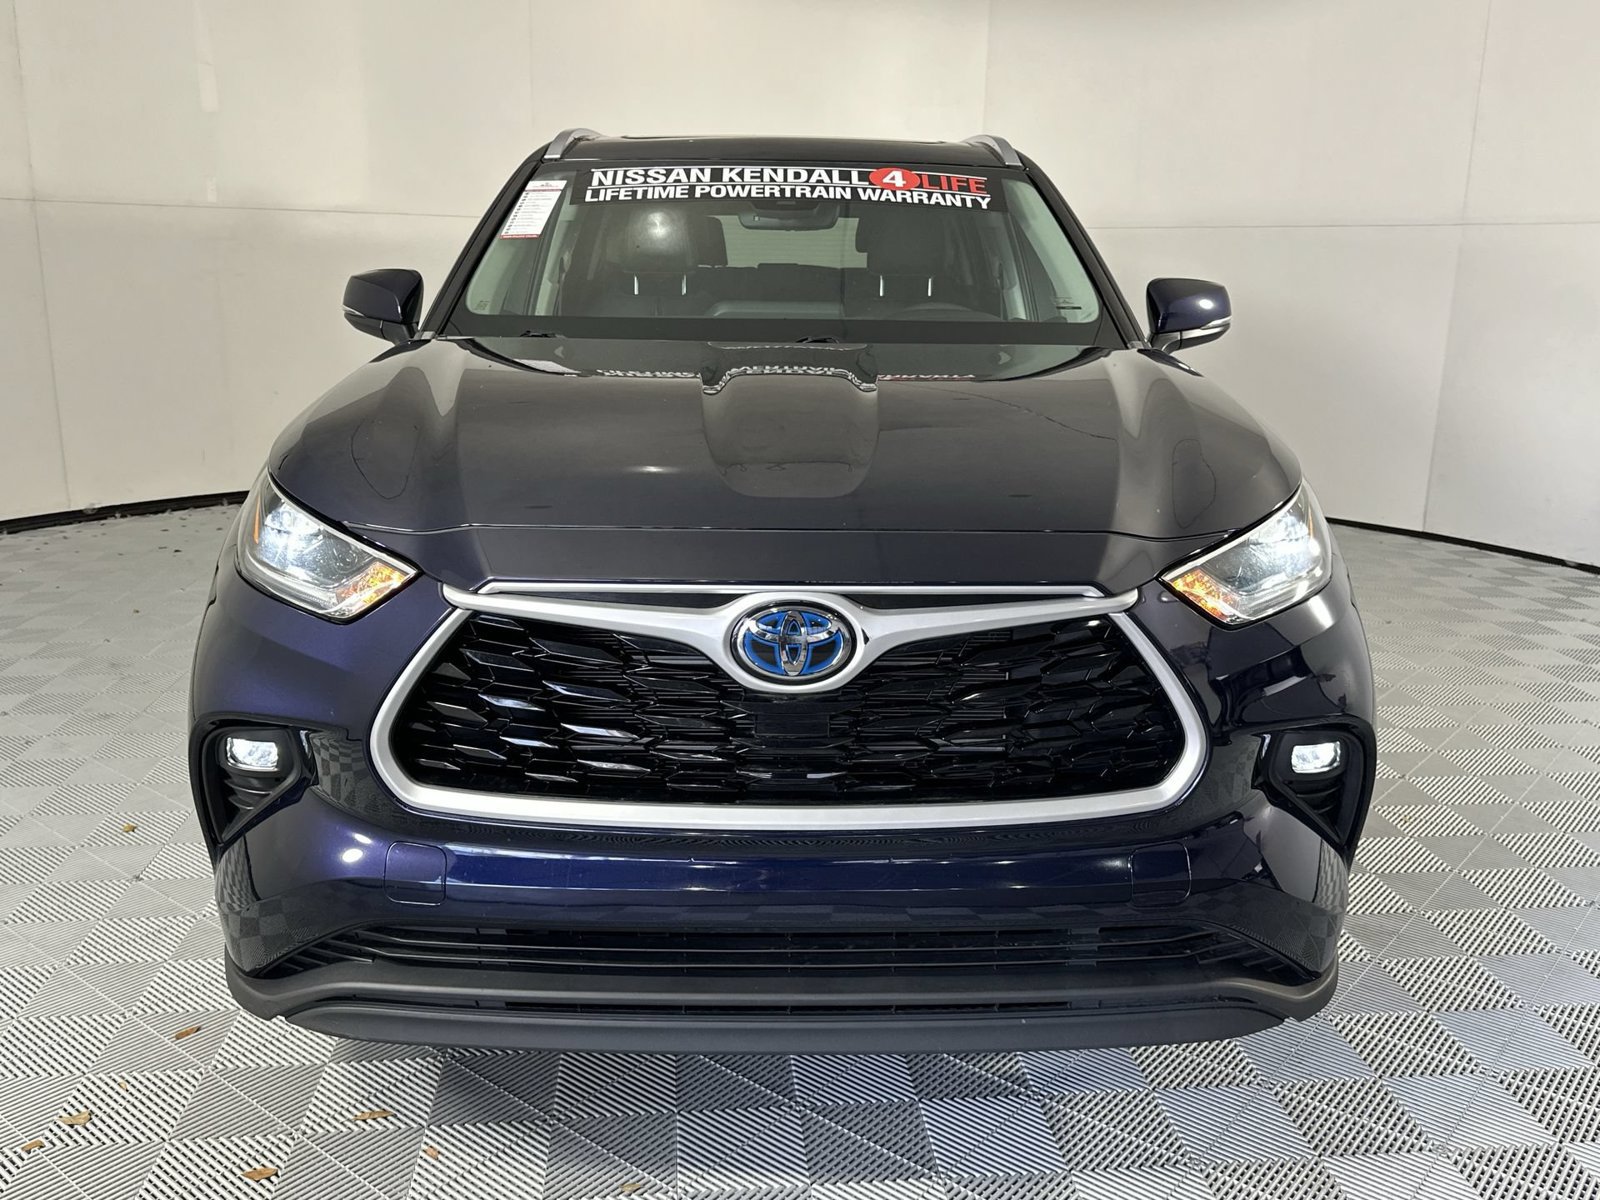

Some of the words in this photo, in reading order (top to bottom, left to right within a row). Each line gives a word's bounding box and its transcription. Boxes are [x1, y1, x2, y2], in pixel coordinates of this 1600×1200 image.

[591, 168, 711, 187] NISSAN
[722, 168, 869, 185] KENDALL
[882, 170, 907, 188] 4
[921, 174, 988, 194] LIFE
[585, 186, 689, 202] LIFETIME
[694, 185, 851, 199] POWERTRAIN
[857, 188, 991, 210] WARRANTY
